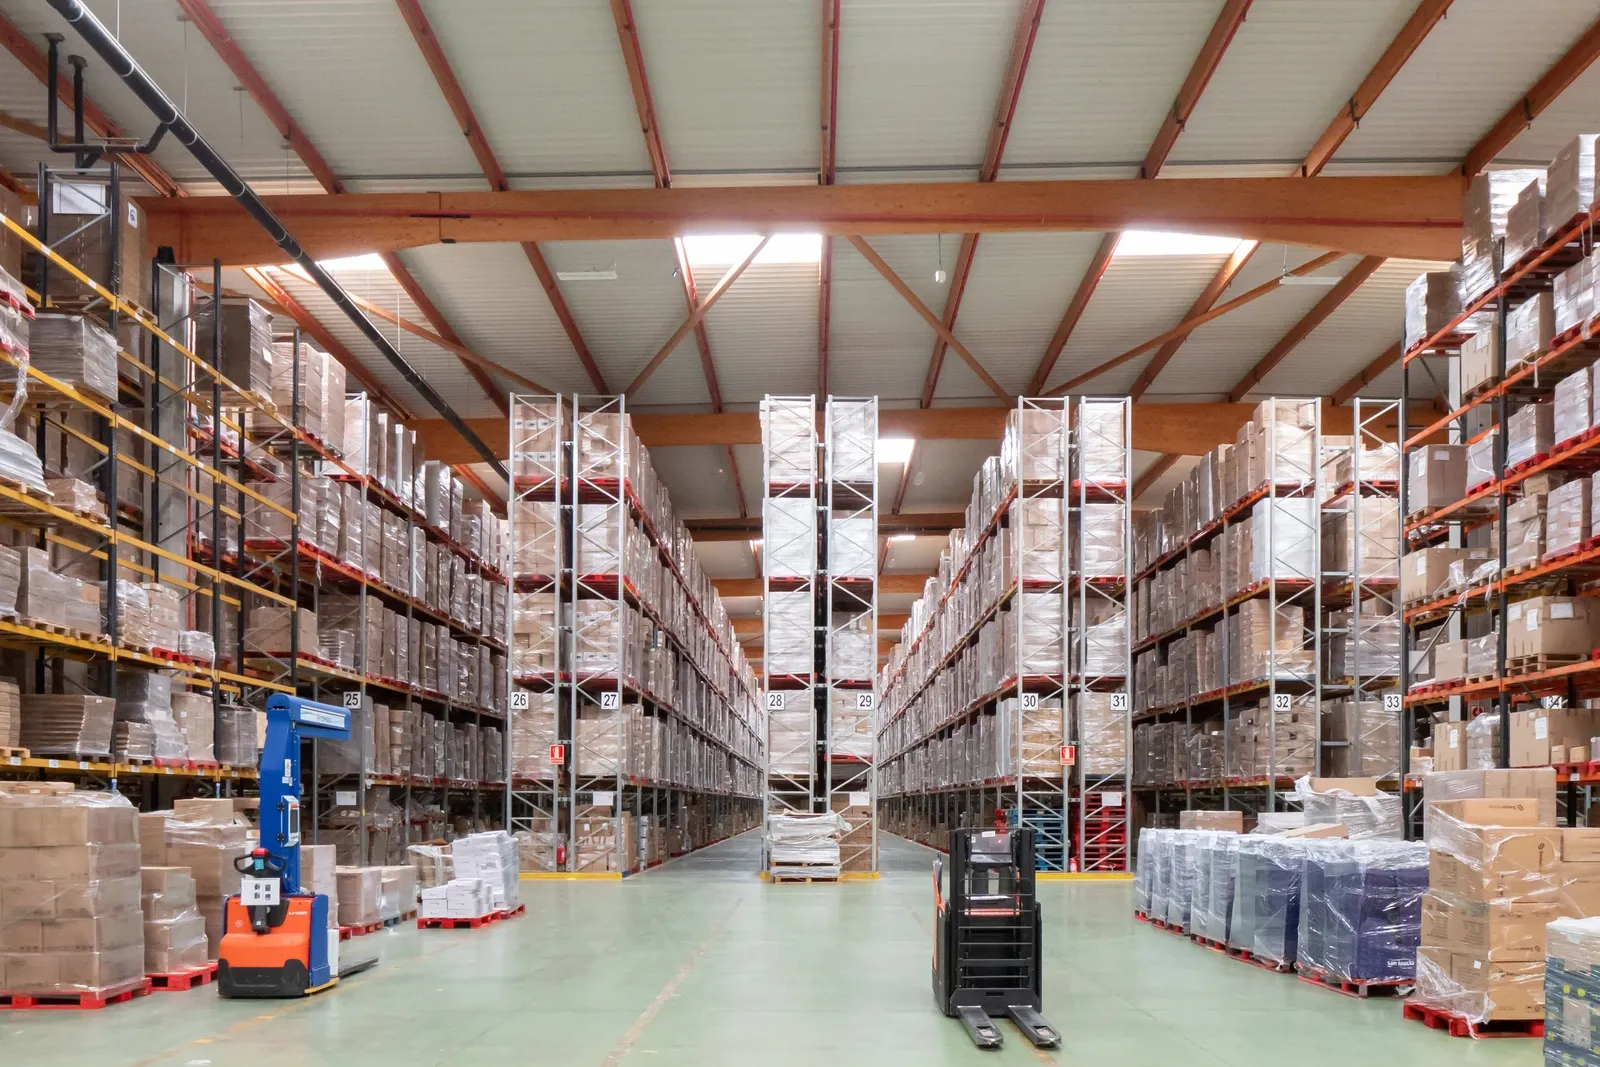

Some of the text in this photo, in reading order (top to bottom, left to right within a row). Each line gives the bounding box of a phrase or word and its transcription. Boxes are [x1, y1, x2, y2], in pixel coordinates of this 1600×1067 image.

[345, 694, 358, 705] 25
[513, 694, 526, 706] 26
[604, 694, 616, 706] 27
[770, 694, 782, 706] 28
[860, 694, 872, 707] 29
[1024, 694, 1036, 707] 30
[1113, 694, 1126, 707] 31
[1276, 695, 1289, 708] 32
[1386, 695, 1400, 708] 33
